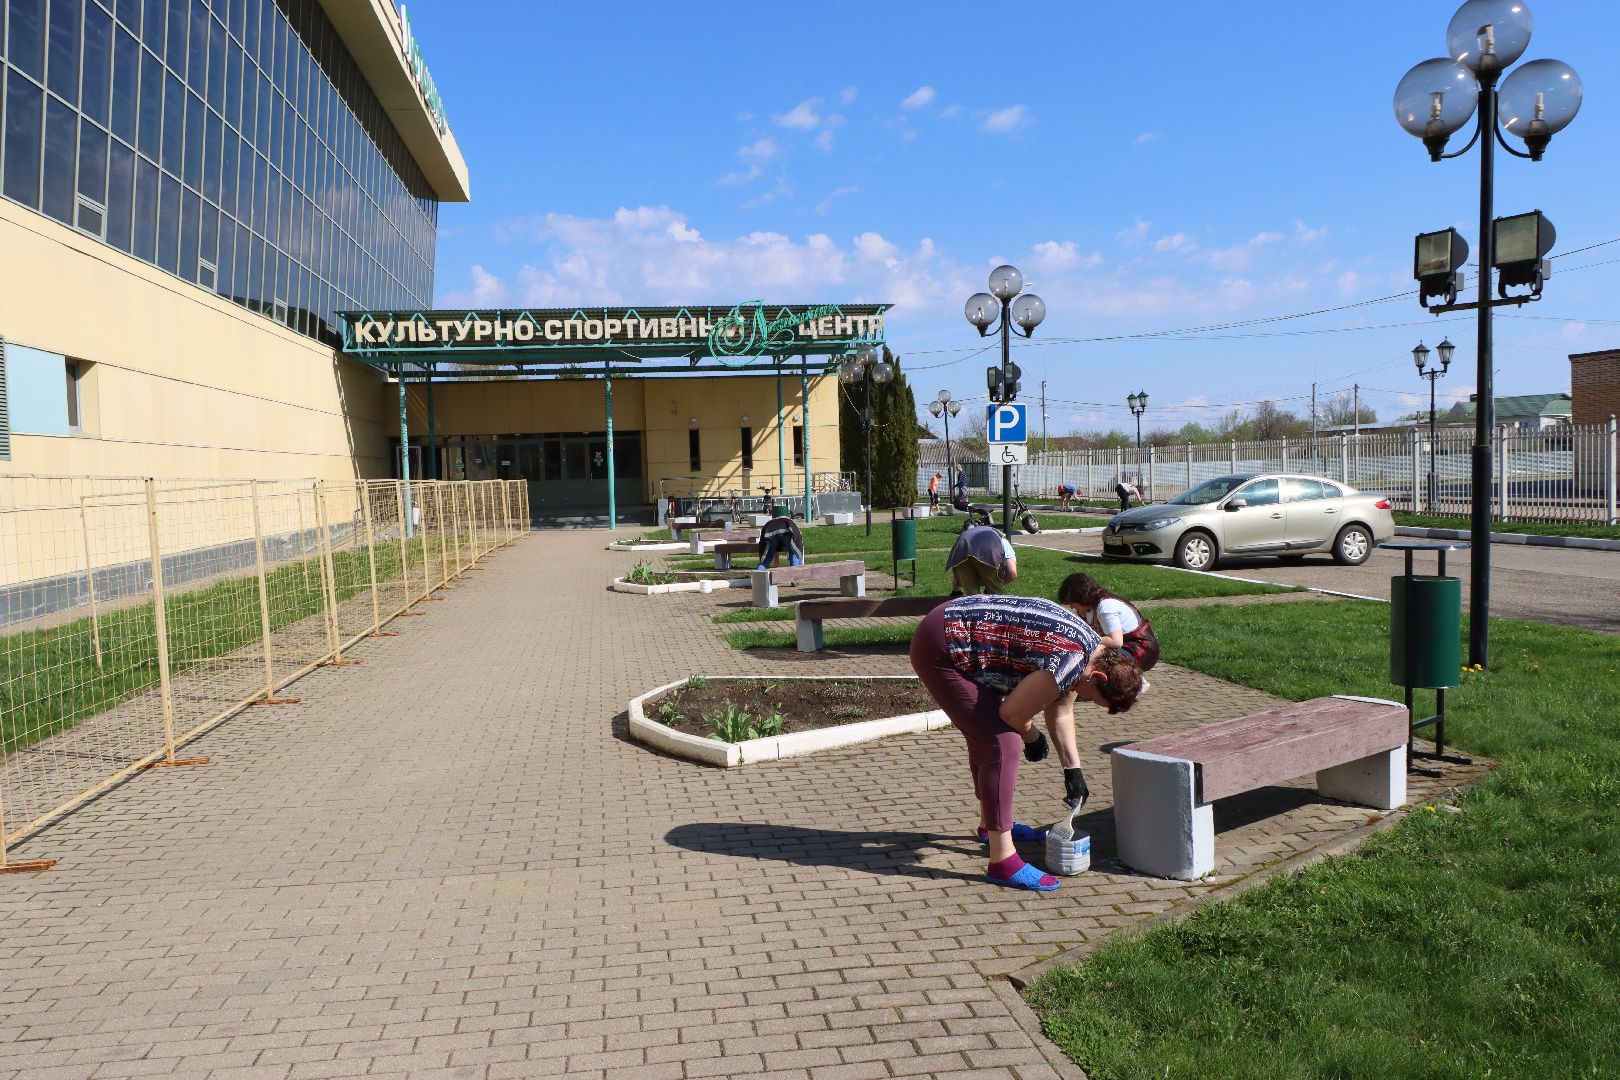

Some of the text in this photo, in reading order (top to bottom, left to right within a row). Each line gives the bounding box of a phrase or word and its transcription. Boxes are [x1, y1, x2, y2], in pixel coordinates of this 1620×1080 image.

[798, 315, 885, 340] ЦЕНТР
[995, 405, 1020, 441] P
[984, 611, 1003, 622] PEACE
[1055, 622, 1077, 639] PEACE
